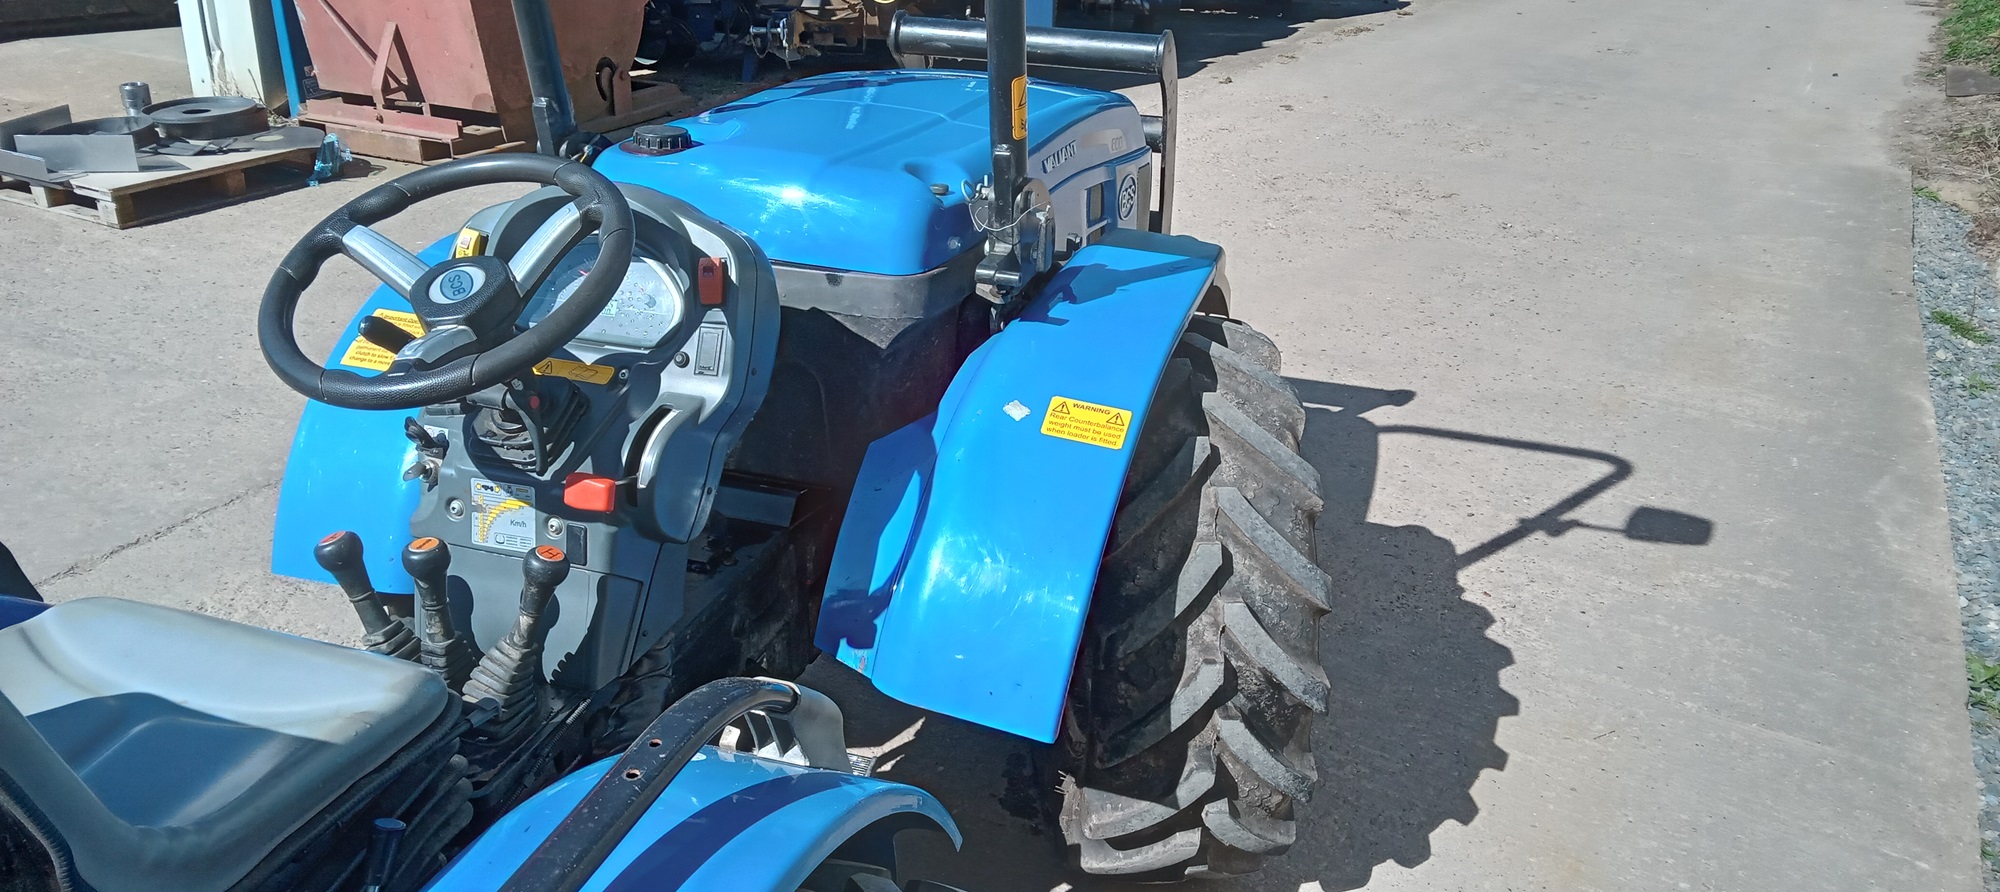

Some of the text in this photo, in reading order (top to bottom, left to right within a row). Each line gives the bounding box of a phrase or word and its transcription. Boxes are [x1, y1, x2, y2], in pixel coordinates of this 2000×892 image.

[1041, 139, 1077, 174] VALIANT
[448, 274, 466, 297] BCS
[349, 355, 367, 363] change
[1072, 402, 1111, 415] WARNING
[1048, 420, 1072, 429] weight
[1073, 424, 1091, 433] must
[1103, 430, 1122, 440] used
[1049, 412, 1125, 433] Rear Counterbalance
[1046, 426, 1119, 447] when loader is fitted.
[509, 518, 527, 528] Km/h
